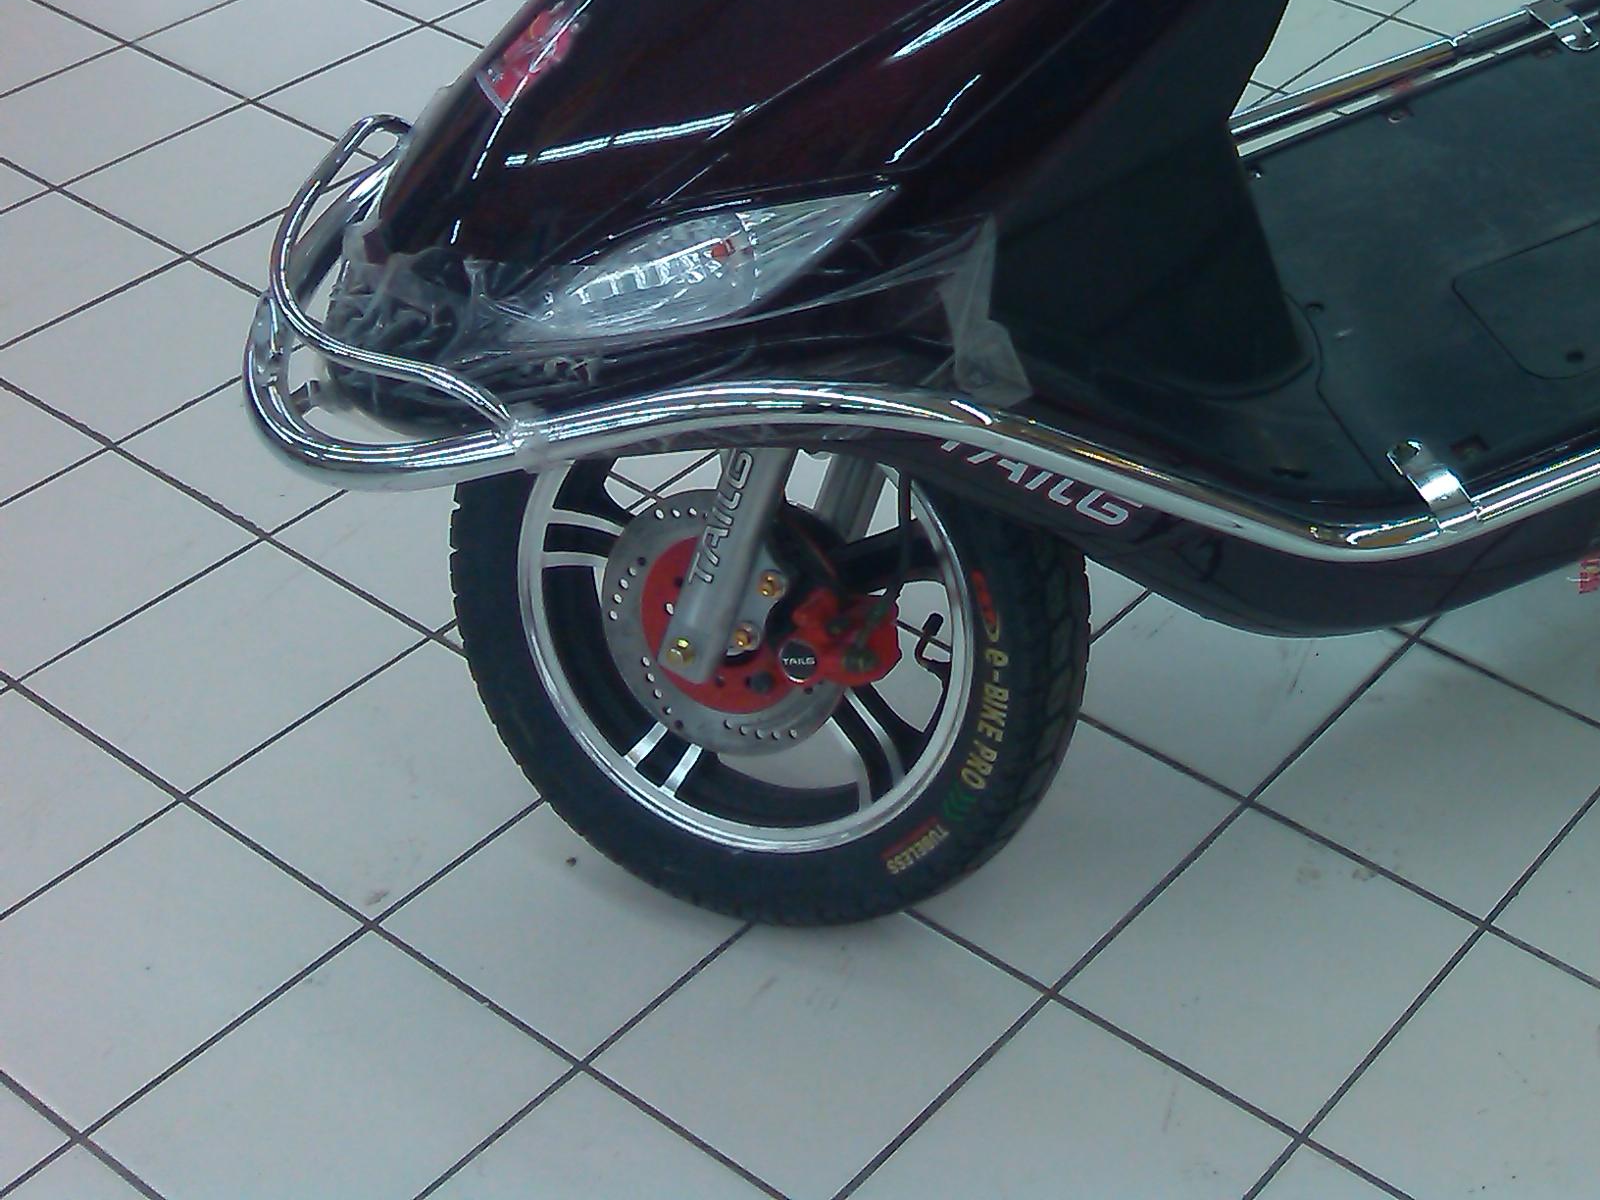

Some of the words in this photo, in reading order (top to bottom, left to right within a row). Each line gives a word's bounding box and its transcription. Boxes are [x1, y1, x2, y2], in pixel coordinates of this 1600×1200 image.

[688, 449, 754, 585] TAILG
[977, 648, 1009, 742] e-BIKE
[960, 738, 1000, 790] PRO
[887, 824, 949, 875] TUBELESS
